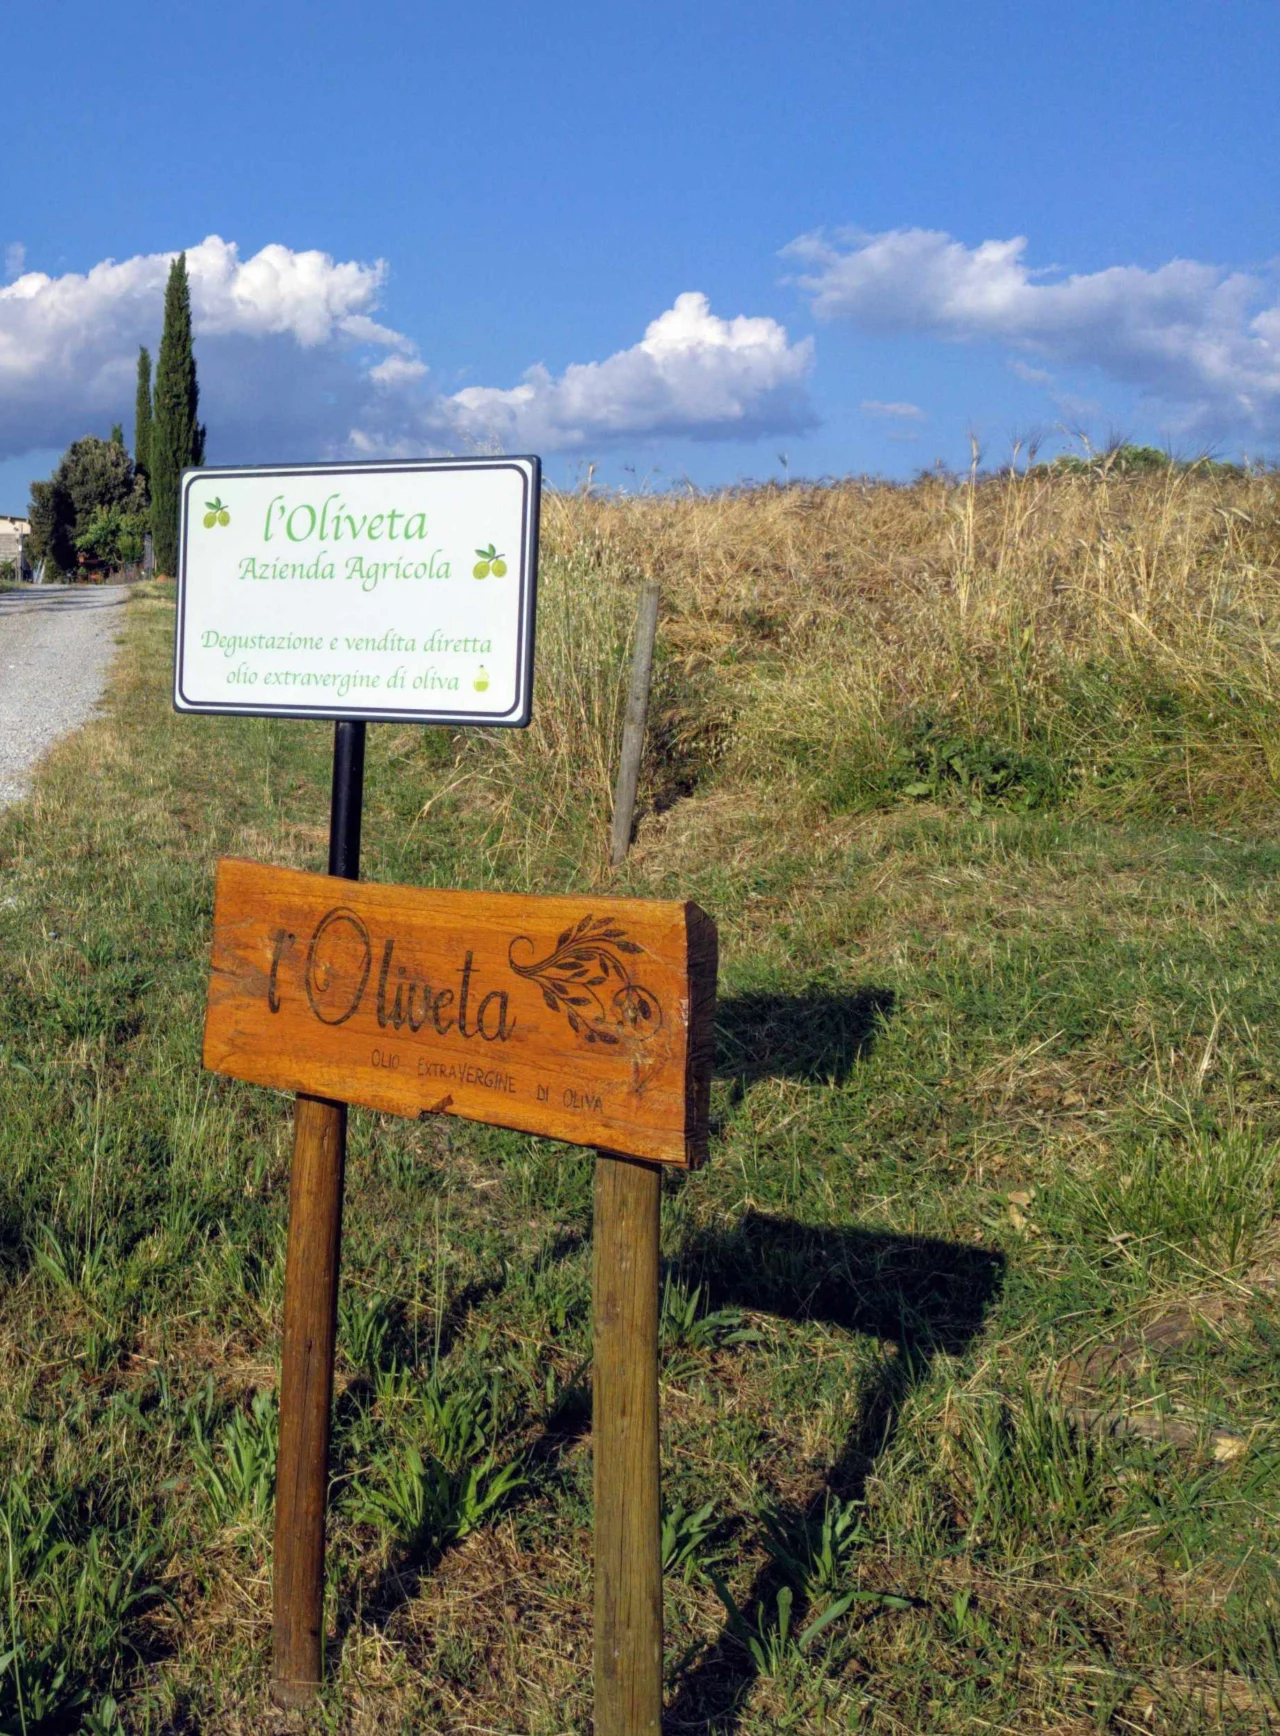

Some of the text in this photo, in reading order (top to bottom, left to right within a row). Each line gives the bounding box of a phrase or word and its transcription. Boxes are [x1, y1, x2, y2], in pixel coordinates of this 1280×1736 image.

[263, 493, 428, 542] l'Oliveta
[238, 549, 452, 592] Azienda Agricola
[201, 628, 492, 657] Degustazione e vendita diretta
[226, 662, 459, 696] olio extravergine di oliva
[267, 906, 517, 1042] l'Oliveta
[371, 1049, 400, 1069] OLIO
[536, 1084, 549, 1102] DI
[563, 1088, 603, 1114] OLIVA
